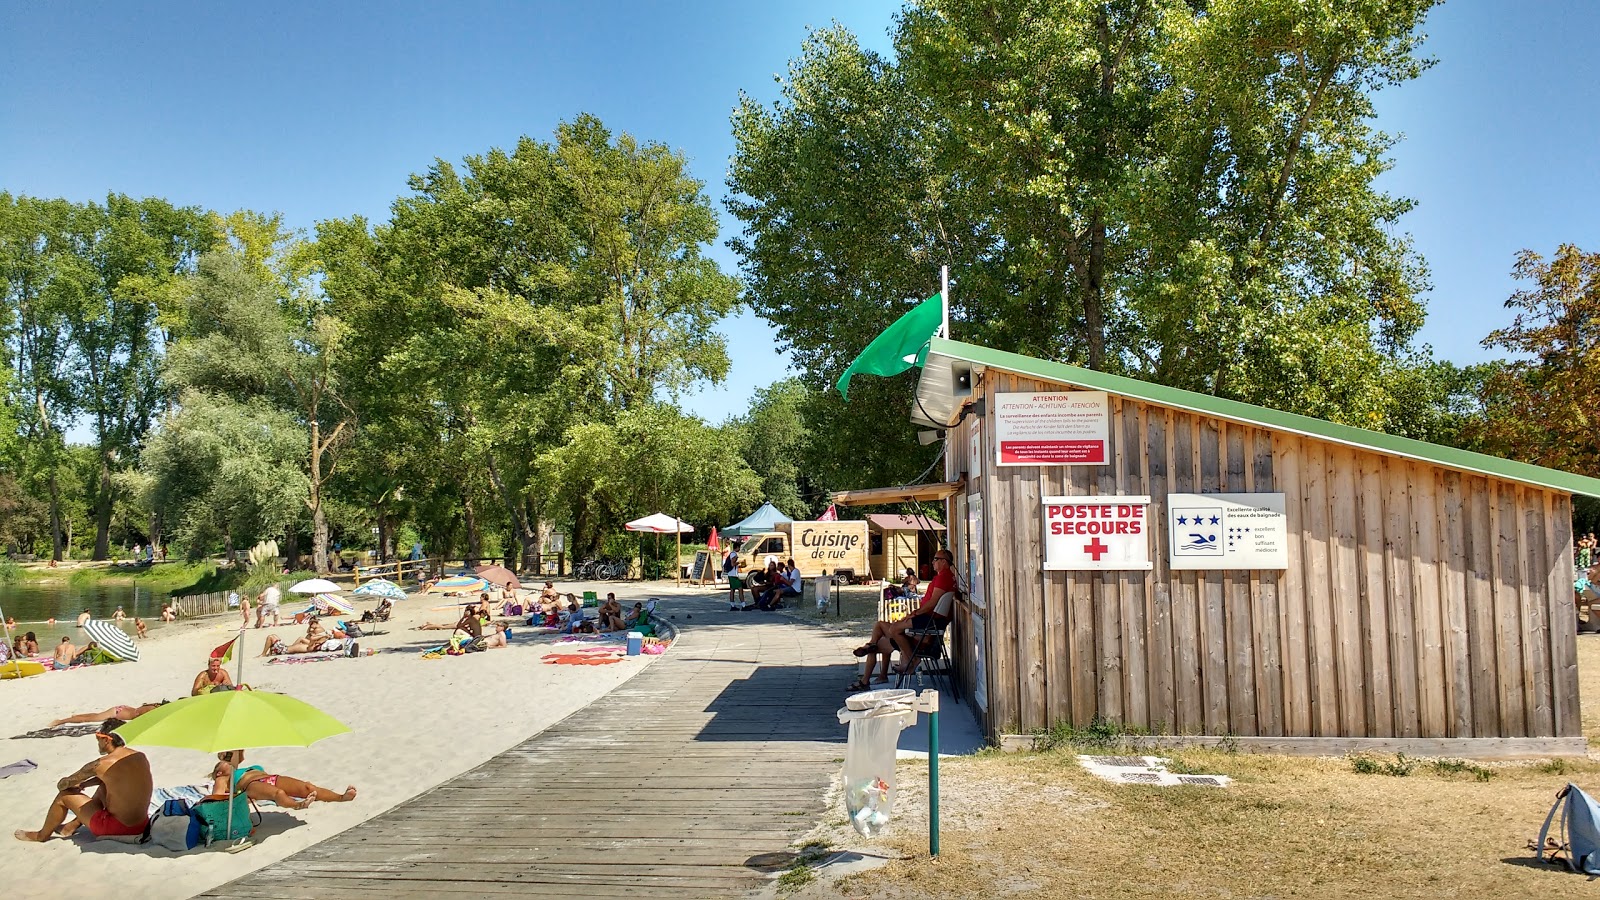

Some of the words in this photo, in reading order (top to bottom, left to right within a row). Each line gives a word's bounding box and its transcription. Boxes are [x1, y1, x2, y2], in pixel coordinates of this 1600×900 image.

[1048, 505, 1112, 518] POSTE
[1118, 505, 1143, 518] DE
[1051, 521, 1141, 535] SECOURS
[802, 528, 859, 550] Cuisine
[811, 547, 824, 558] de
